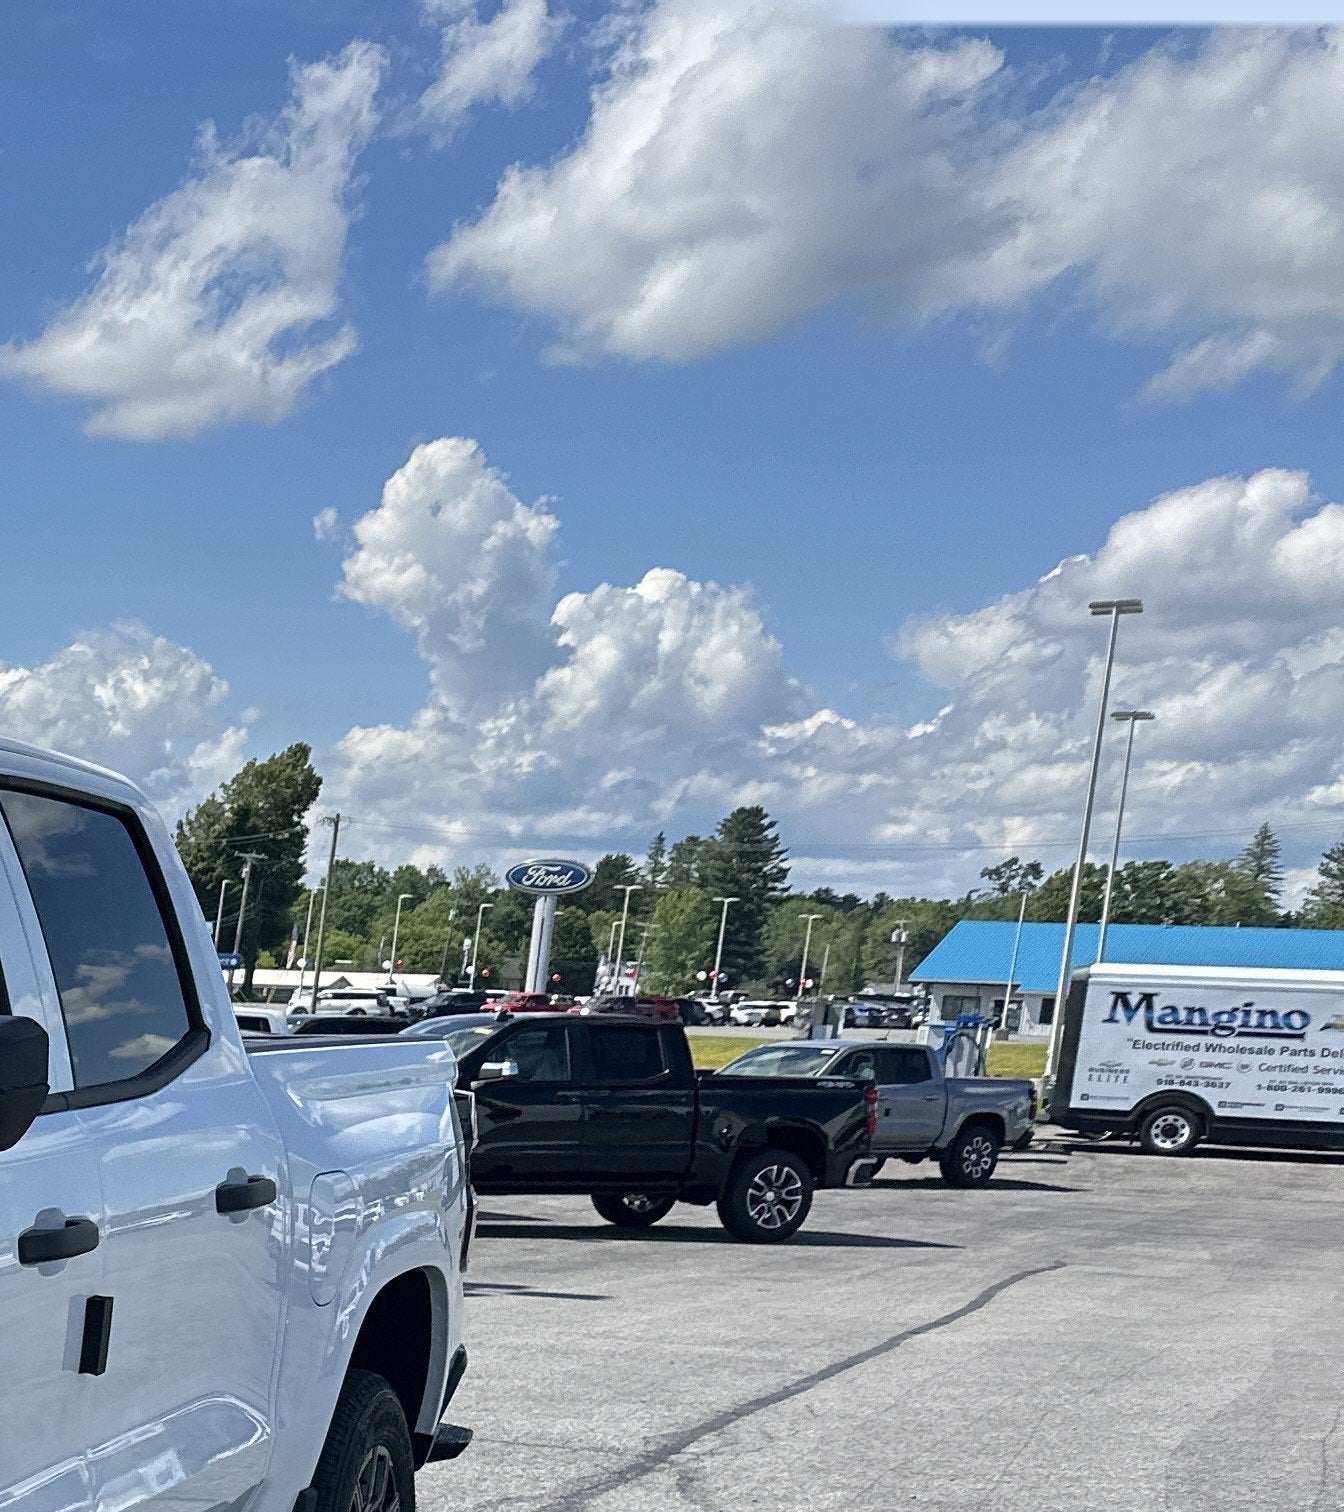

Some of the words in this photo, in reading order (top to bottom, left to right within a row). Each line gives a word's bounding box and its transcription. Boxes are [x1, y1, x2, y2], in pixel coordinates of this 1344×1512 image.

[522, 865, 574, 887] Ford
[1101, 990, 1312, 1041] Mangino
[1204, 1043, 1276, 1056] Wholesale
[1280, 1046, 1316, 1058] Parts
[1199, 1061, 1233, 1070] GMC
[1258, 1062, 1309, 1074] Certified
[1088, 1074, 1130, 1085] ELITE
